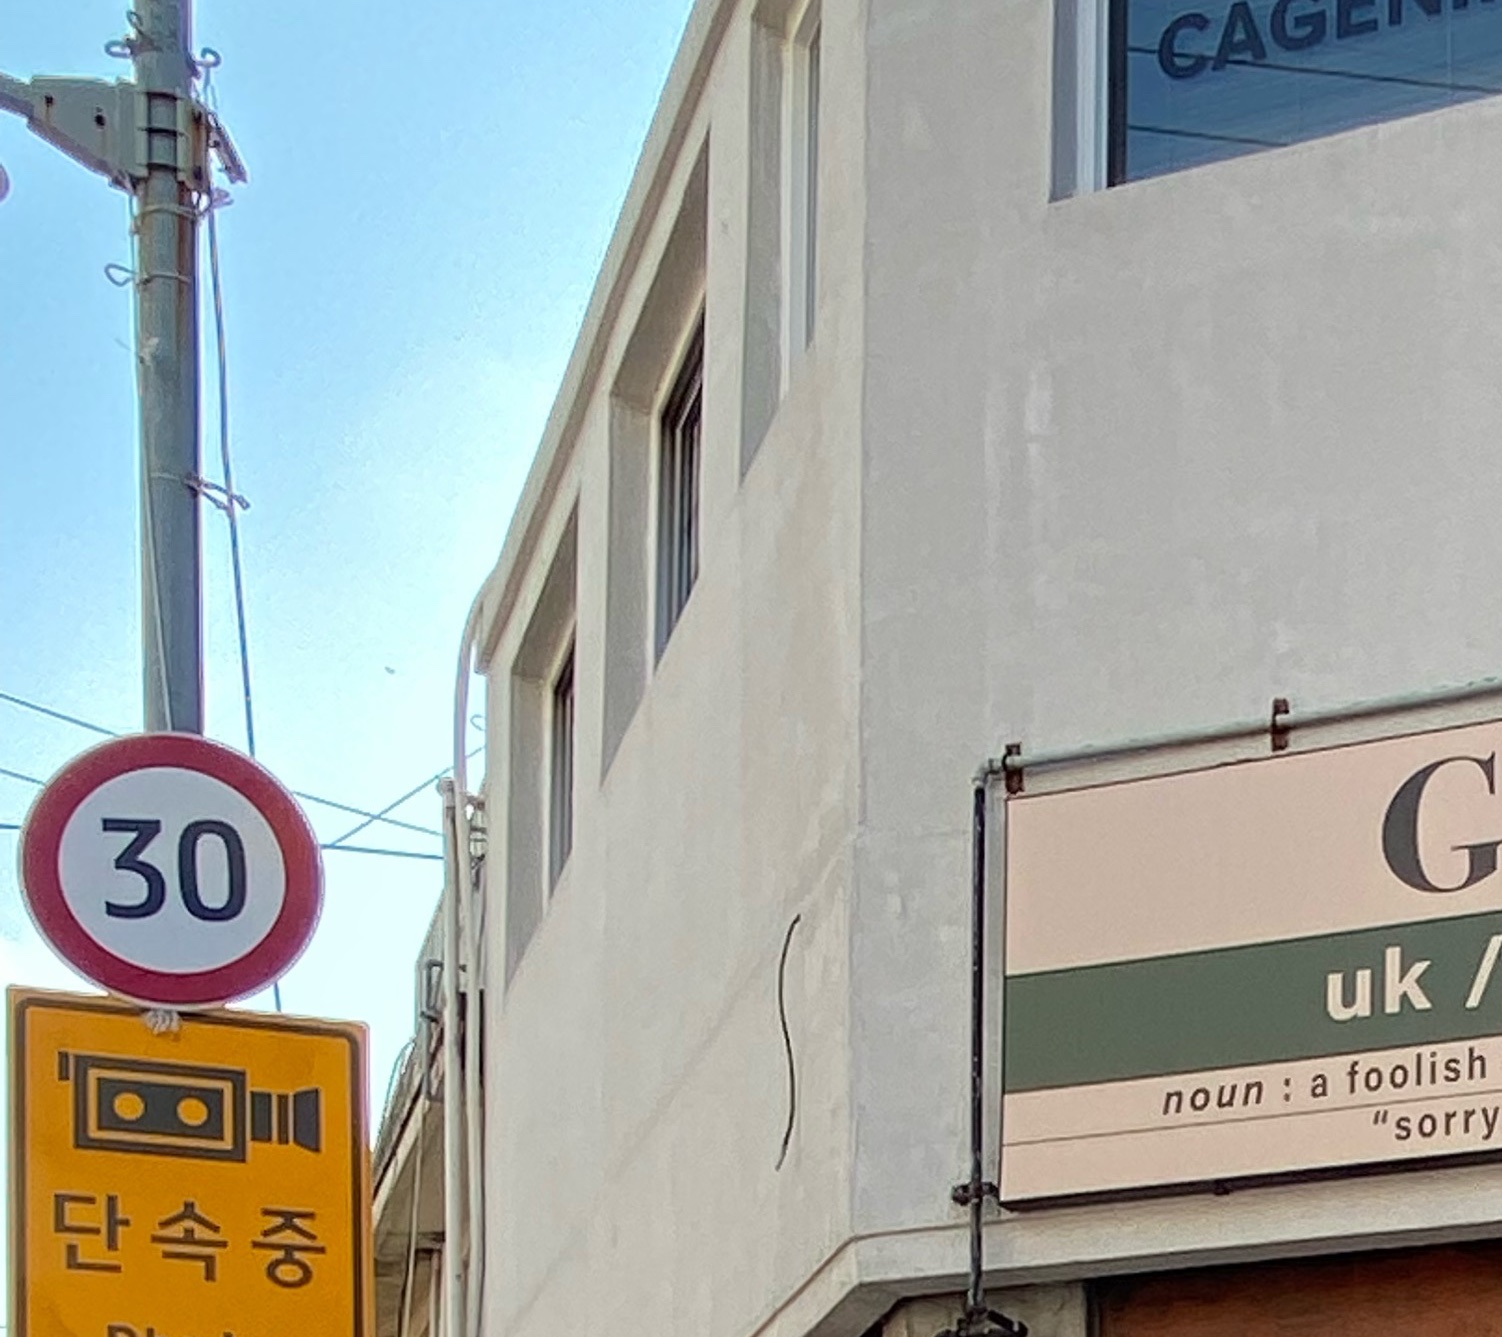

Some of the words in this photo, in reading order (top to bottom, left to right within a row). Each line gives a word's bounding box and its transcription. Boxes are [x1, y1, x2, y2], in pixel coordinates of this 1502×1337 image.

[1158, 0, 1496, 80] CAGE
[100, 816, 250, 923] 30
[1325, 945, 1433, 1022] uk
[1162, 1079, 1265, 1116] noun
[1310, 1073, 1328, 1098] a
[1348, 1048, 1488, 1094] foolish
